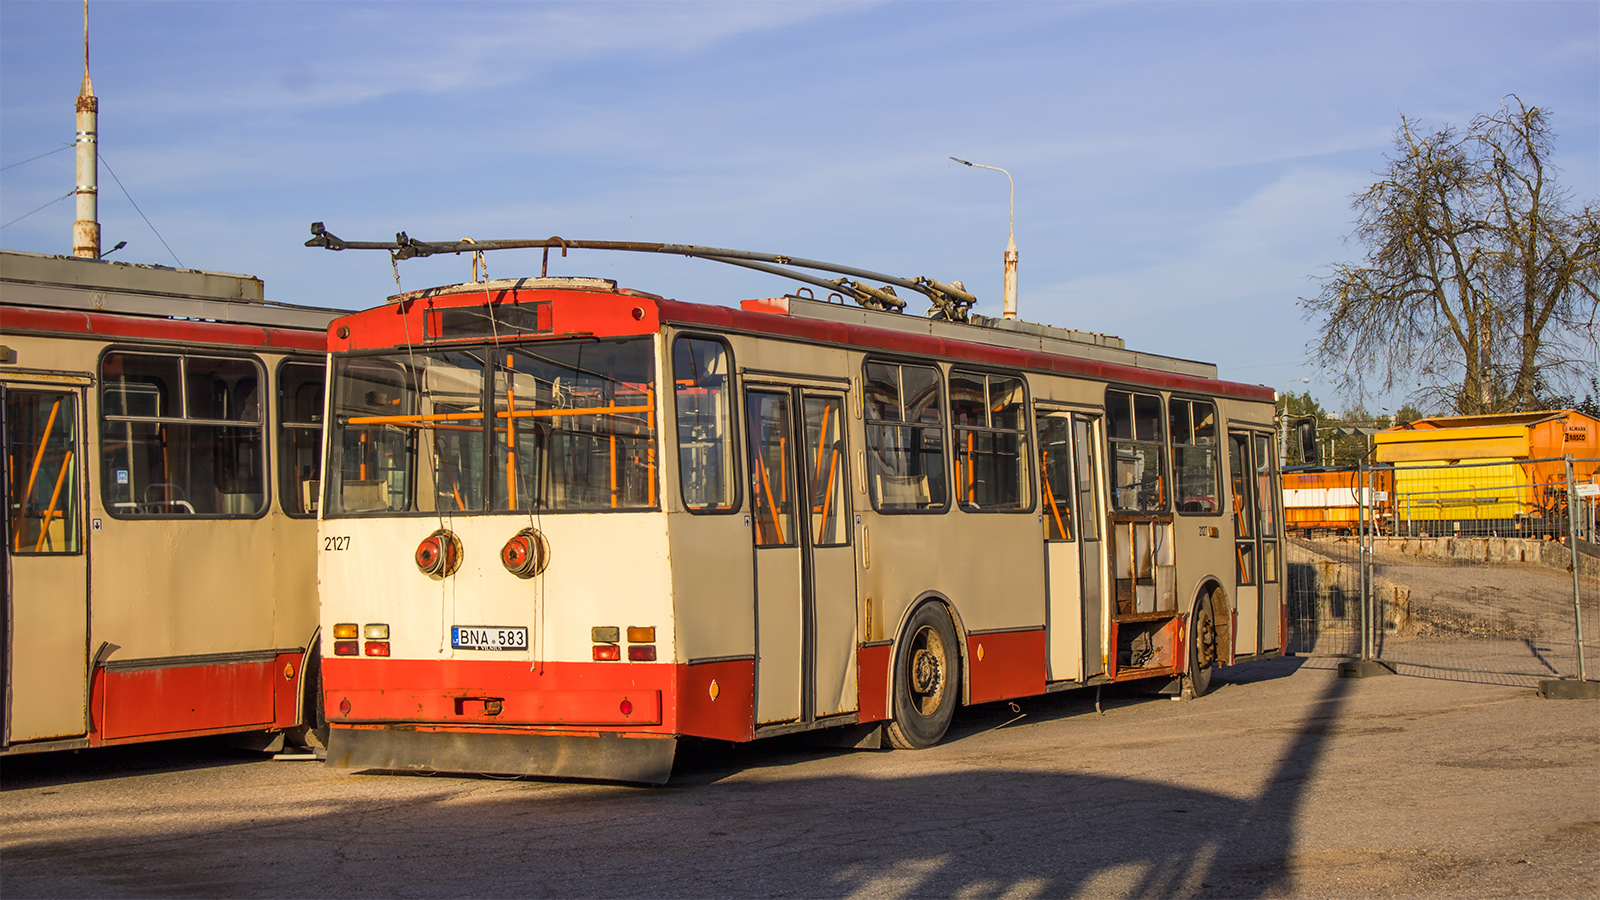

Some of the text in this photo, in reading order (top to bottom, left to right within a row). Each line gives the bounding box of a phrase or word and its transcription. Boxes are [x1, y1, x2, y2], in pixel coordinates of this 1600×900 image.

[324, 536, 351, 551] 2127
[460, 630, 524, 646] BNA 583
